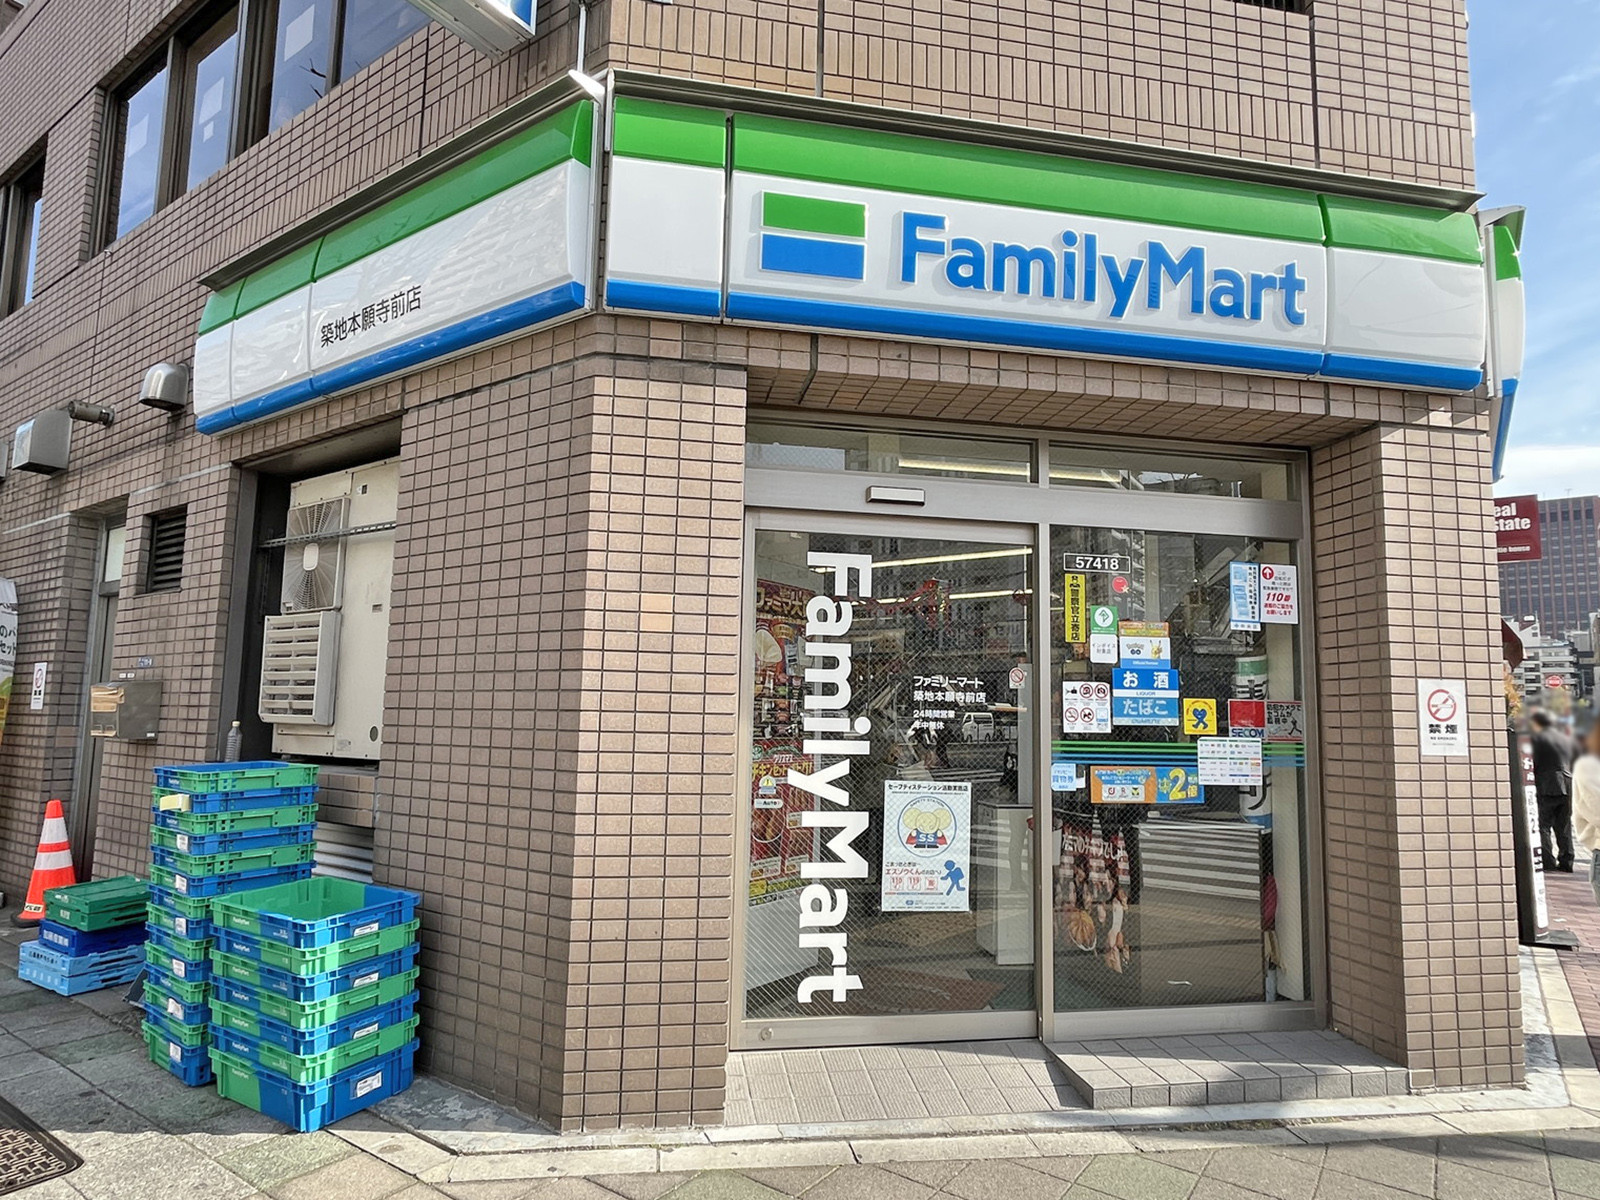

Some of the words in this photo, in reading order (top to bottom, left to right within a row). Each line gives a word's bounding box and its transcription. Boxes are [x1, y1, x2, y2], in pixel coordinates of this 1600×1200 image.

[899, 210, 1307, 328] FamilyMart
[319, 284, 423, 349] 築地本願寺前店
[1493, 502, 1517, 518] eal
[1494, 517, 1532, 532] state
[1075, 556, 1119, 570] 57418
[913, 675, 985, 689] ファミリーマート
[1122, 671, 1170, 689] お酒
[913, 690, 987, 703] 築地本願寺前店
[1123, 699, 1168, 715] たばこ
[1231, 728, 1265, 738] SECOM
[1428, 723, 1458, 734] 禁煙
[786, 553, 874, 1005] FamilyMart
[919, 834, 935, 842] SS
